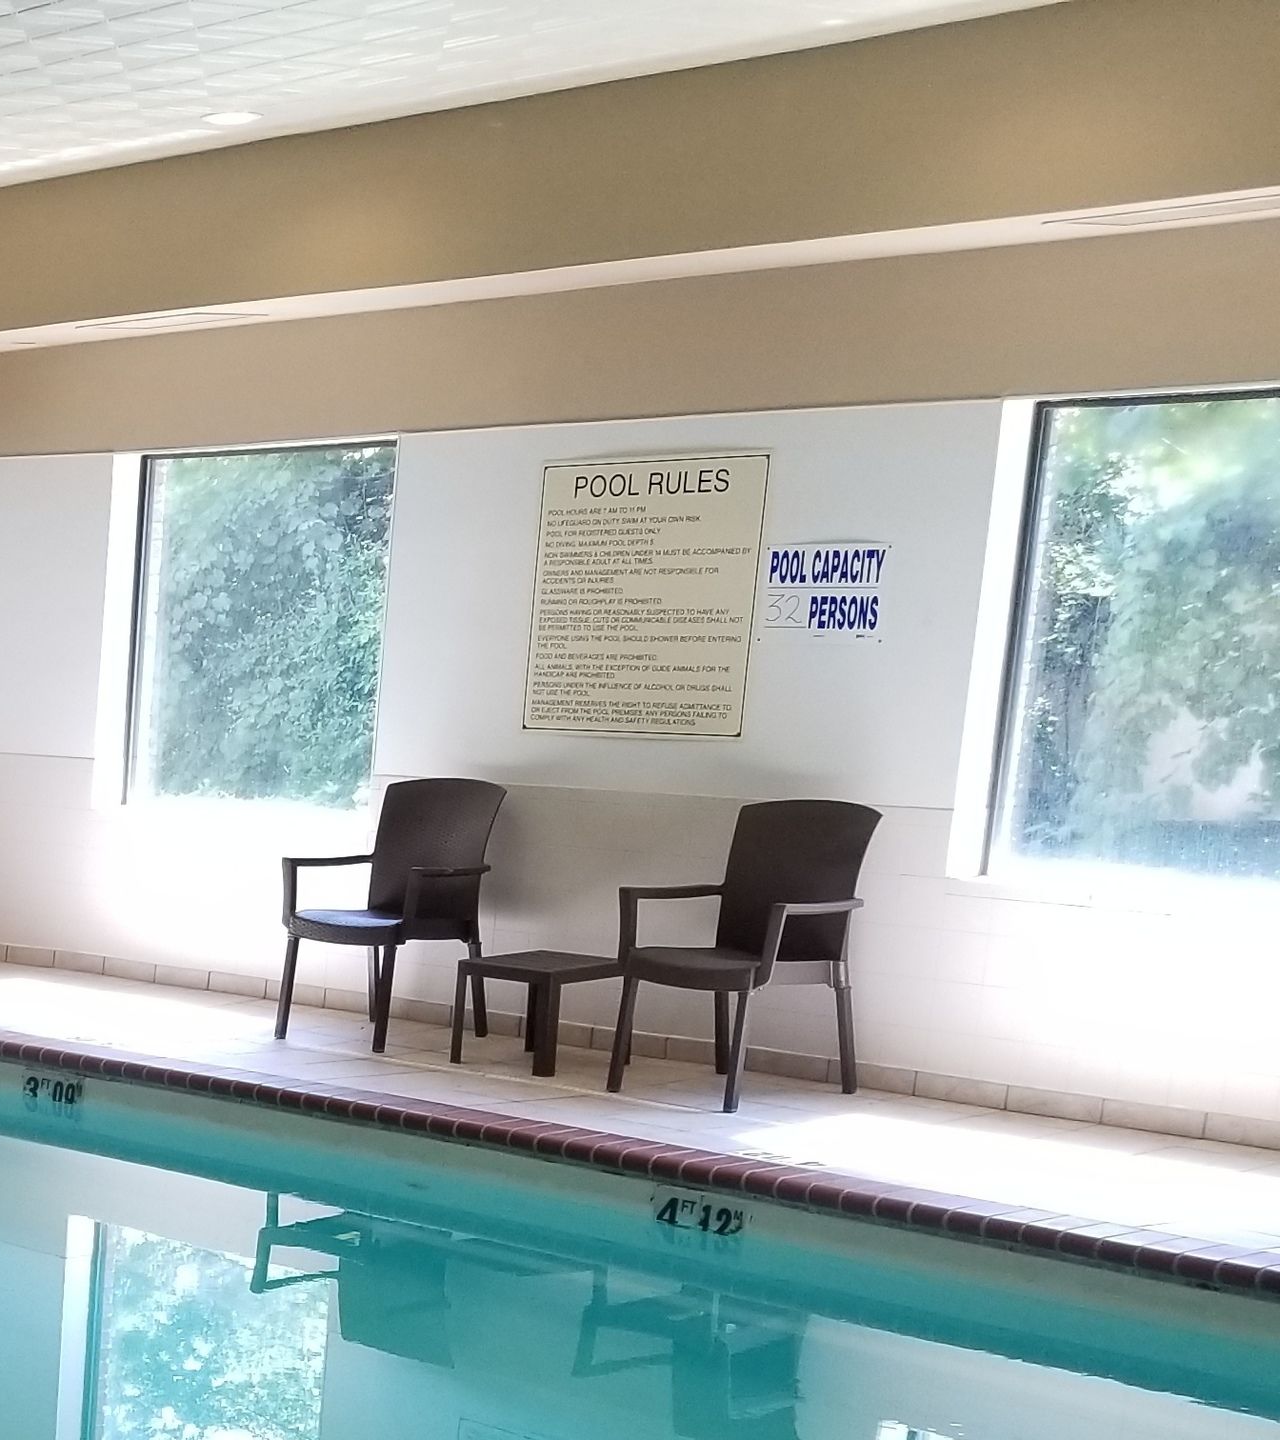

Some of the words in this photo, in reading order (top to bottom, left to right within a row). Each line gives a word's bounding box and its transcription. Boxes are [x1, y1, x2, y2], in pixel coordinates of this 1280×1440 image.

[575, 474, 639, 498] POOL
[648, 469, 730, 494] RULES
[769, 550, 806, 583] POOL
[812, 549, 886, 583] CAPACITY
[766, 594, 802, 623] 32
[808, 596, 878, 630] PERSONS
[24, 1077, 38, 1098] 3
[41, 1079, 51, 1089] FT
[656, 1198, 678, 1224] 4
[681, 1200, 697, 1215] FT
